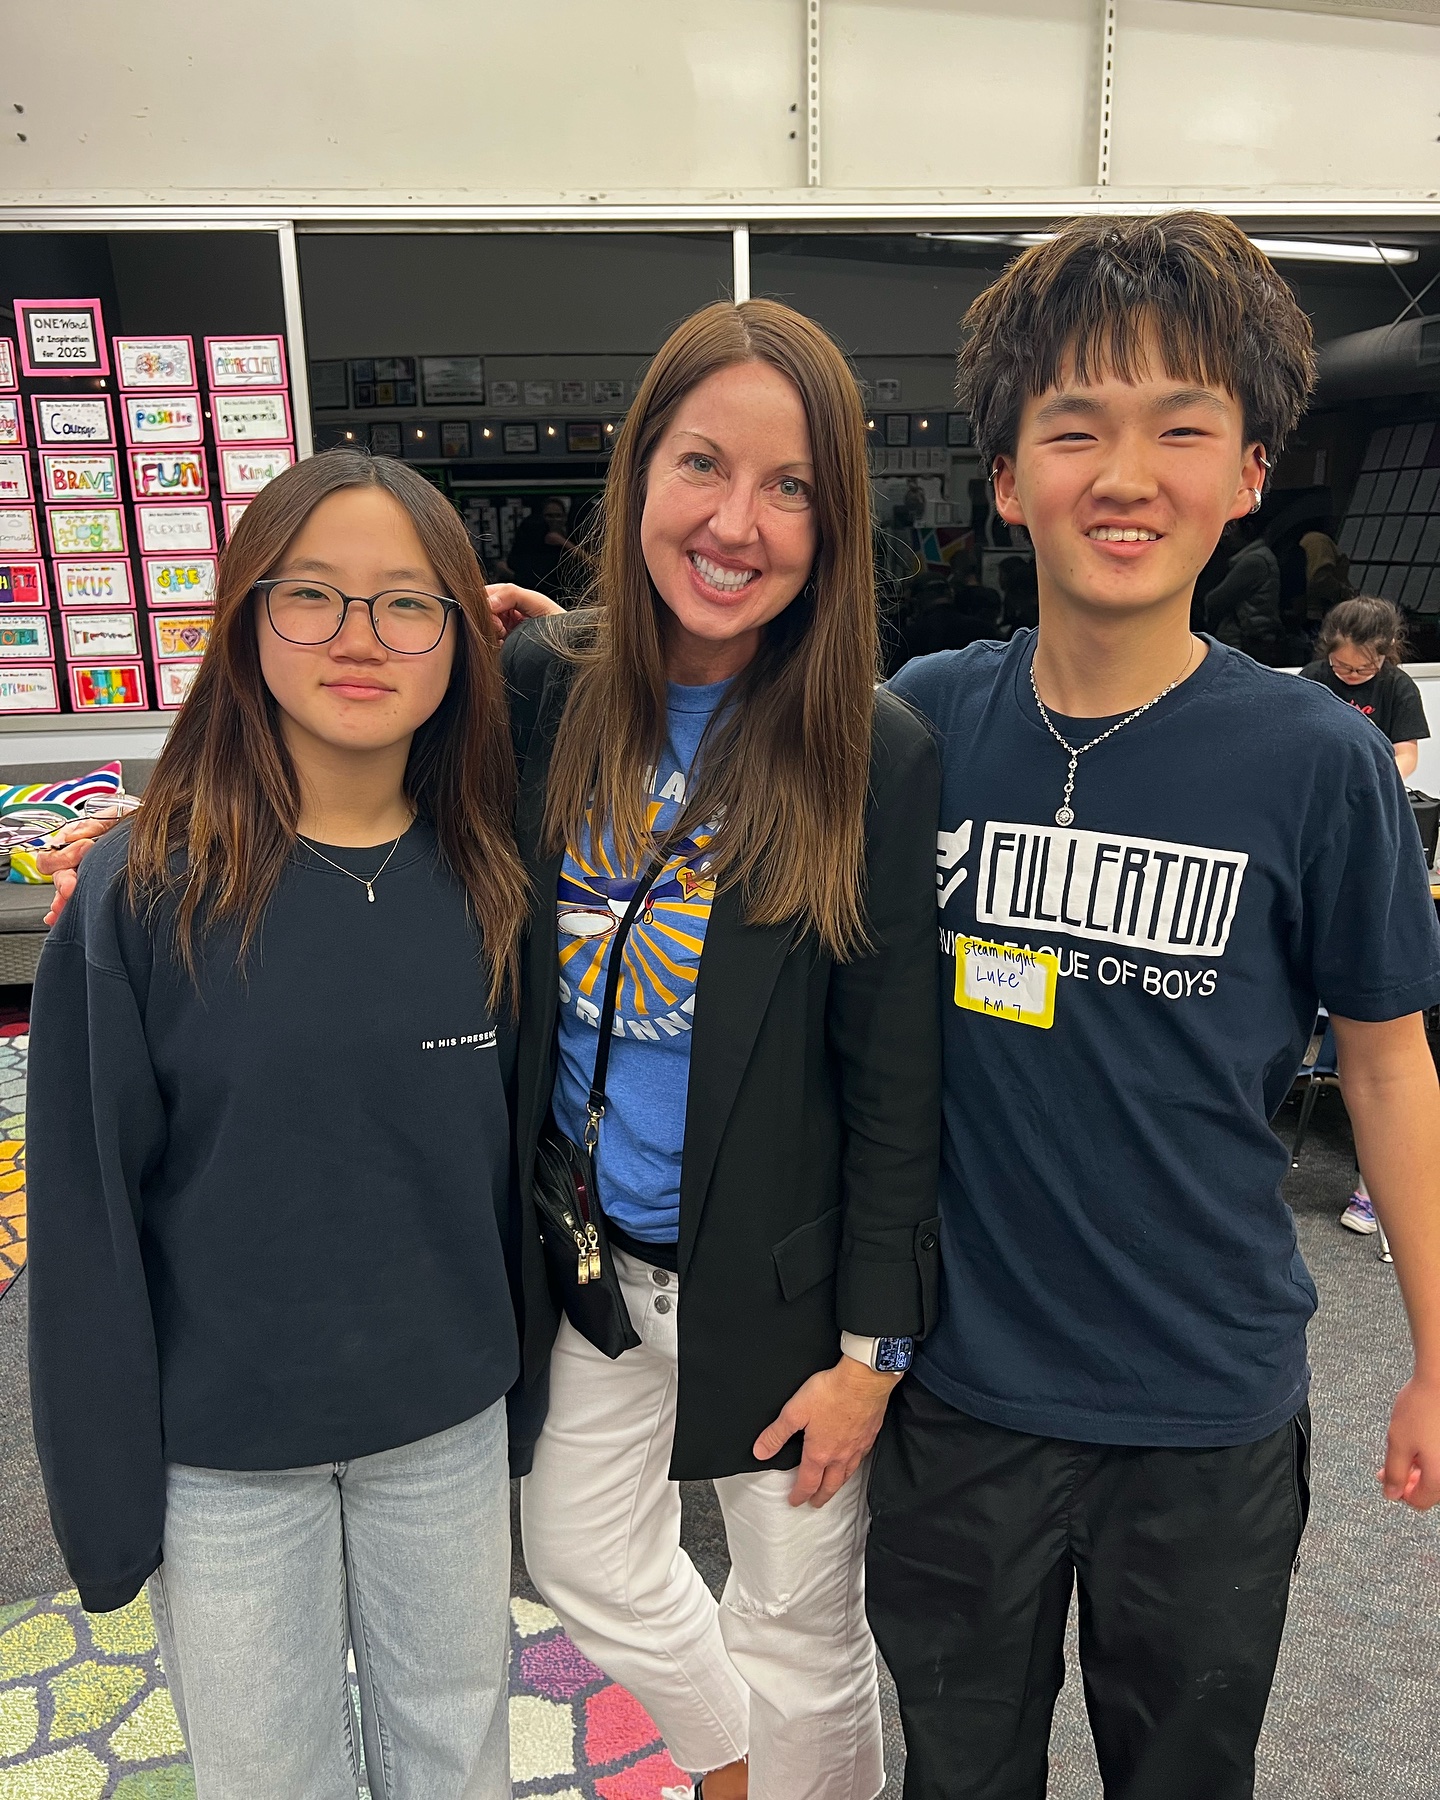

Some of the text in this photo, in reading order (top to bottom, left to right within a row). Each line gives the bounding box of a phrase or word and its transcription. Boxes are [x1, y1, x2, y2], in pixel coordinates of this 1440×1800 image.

[34, 318, 89, 330] ONE Word
[36, 334, 90, 346] of Inspiration
[42, 347, 87, 358] for 2025
[53, 468, 113, 492] BRAVE
[67, 575, 113, 598] FOCUS
[985, 831, 1239, 947] FULLERTON
[1003, 948, 1037, 976] Night
[976, 965, 1020, 988] Luke
[1097, 956, 1138, 985] OF
[1142, 965, 1218, 1000] BOYS
[983, 995, 1022, 1020] RM 7
[422, 1041, 434, 1050] IN
[438, 1038, 457, 1048] HIS
